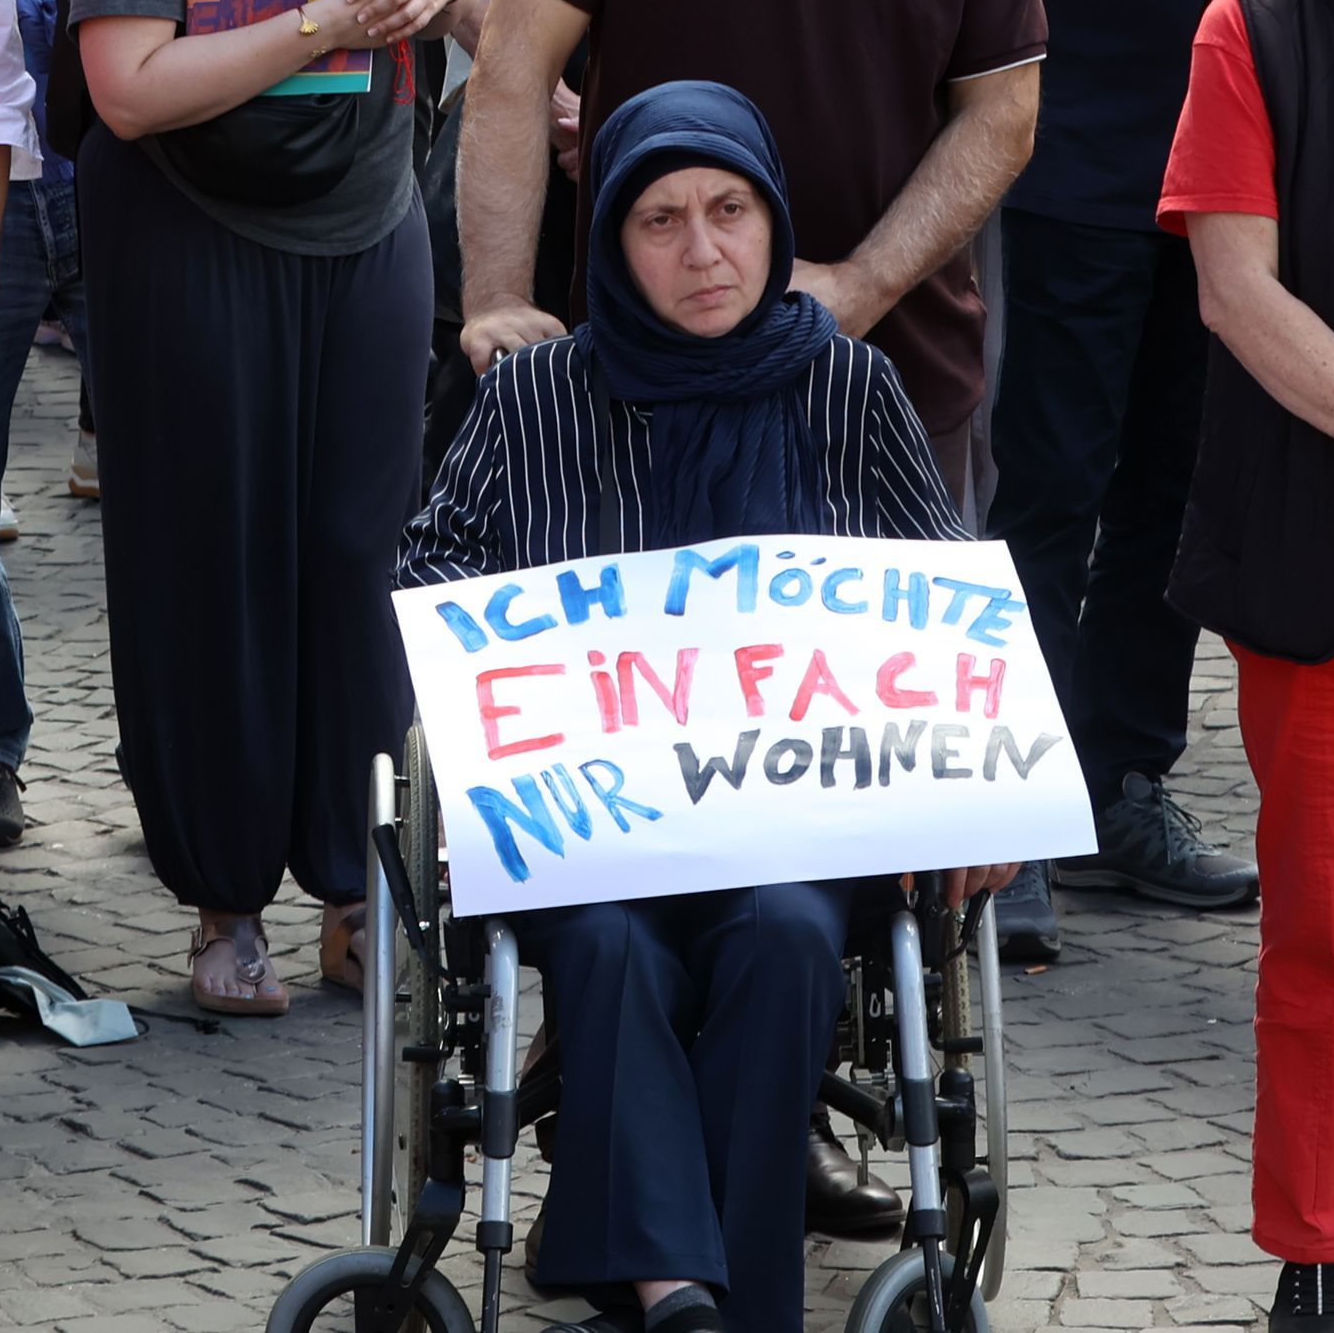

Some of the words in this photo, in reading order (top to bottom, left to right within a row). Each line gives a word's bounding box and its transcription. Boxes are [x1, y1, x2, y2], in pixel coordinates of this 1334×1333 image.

[435, 563, 627, 653] ICH
[665, 543, 1027, 648] MÖCHTE
[465, 758, 665, 884] NUR
[673, 719, 1063, 805] WOHNEN
